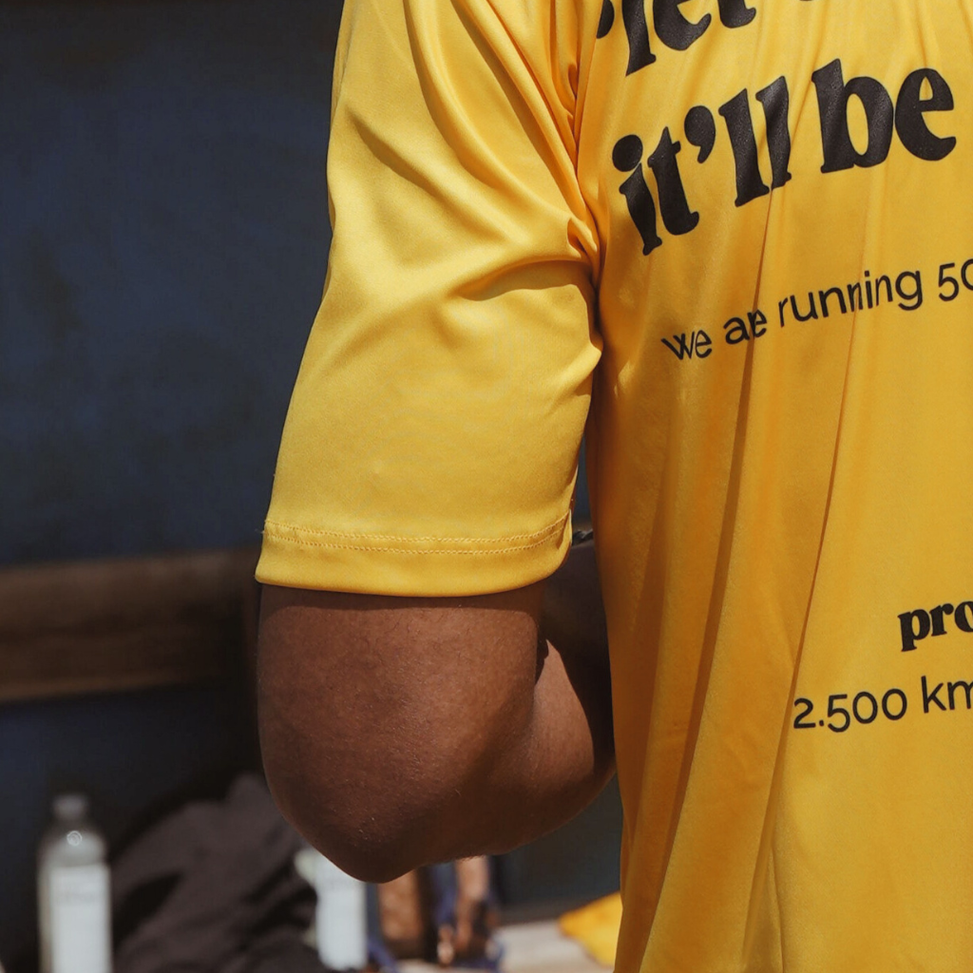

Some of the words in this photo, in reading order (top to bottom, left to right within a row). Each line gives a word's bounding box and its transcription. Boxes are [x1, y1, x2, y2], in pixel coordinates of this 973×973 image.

[612, 76, 792, 257] it'll
[811, 59, 957, 174] be
[659, 329, 713, 361] we
[778, 270, 923, 328] running
[792, 688, 908, 733] 2.500
